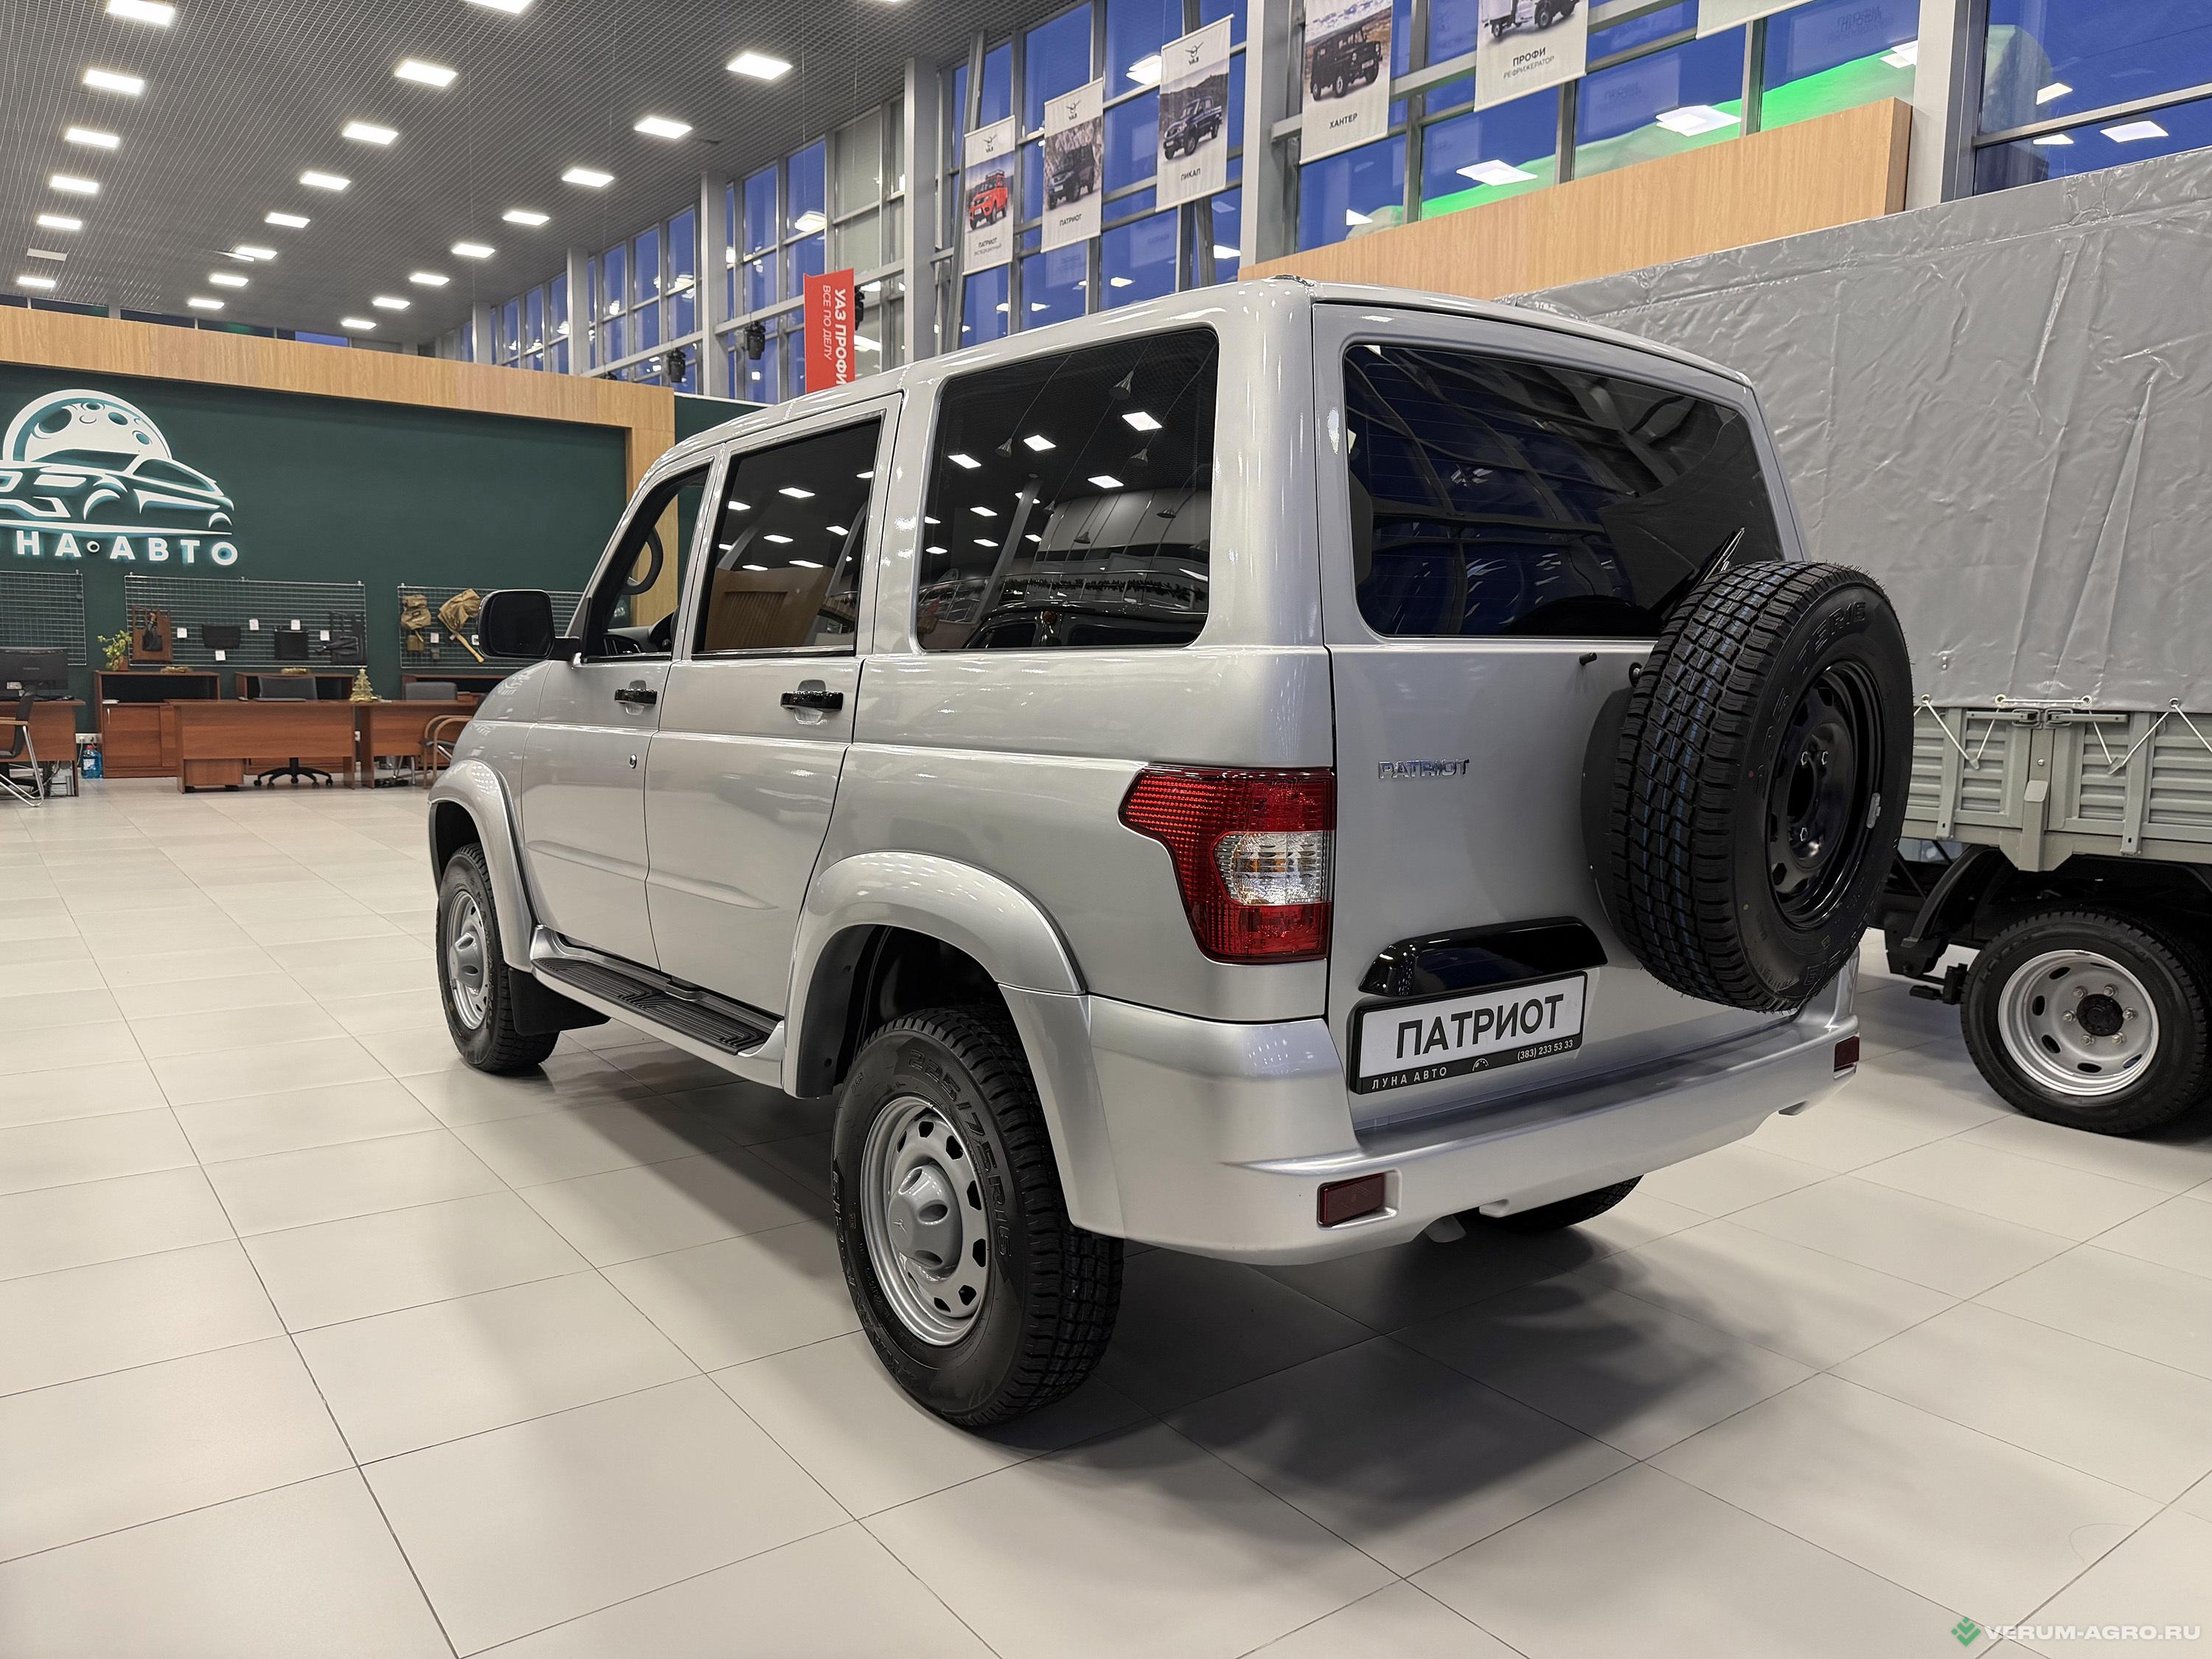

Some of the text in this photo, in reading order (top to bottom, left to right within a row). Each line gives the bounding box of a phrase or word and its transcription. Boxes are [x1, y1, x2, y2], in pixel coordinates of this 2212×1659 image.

[1512, 46, 1546, 67] ПРОФИ
[1329, 113, 1357, 129] ХАНТЕР
[1180, 167, 1201, 181] ПИКАП
[822, 285, 832, 361] ВСЕ ПО ДЕЛУ
[835, 289, 847, 384] УАЗ ПРОФИ
[110, 536, 238, 566] АВТО
[1378, 758, 1470, 779] PATRIOT
[1397, 994, 1564, 1059] ПАТРИОТ
[1517, 1039, 1573, 1061] (383) 233 53 33
[1372, 1066, 1447, 1090] ЛУНА АВТО
